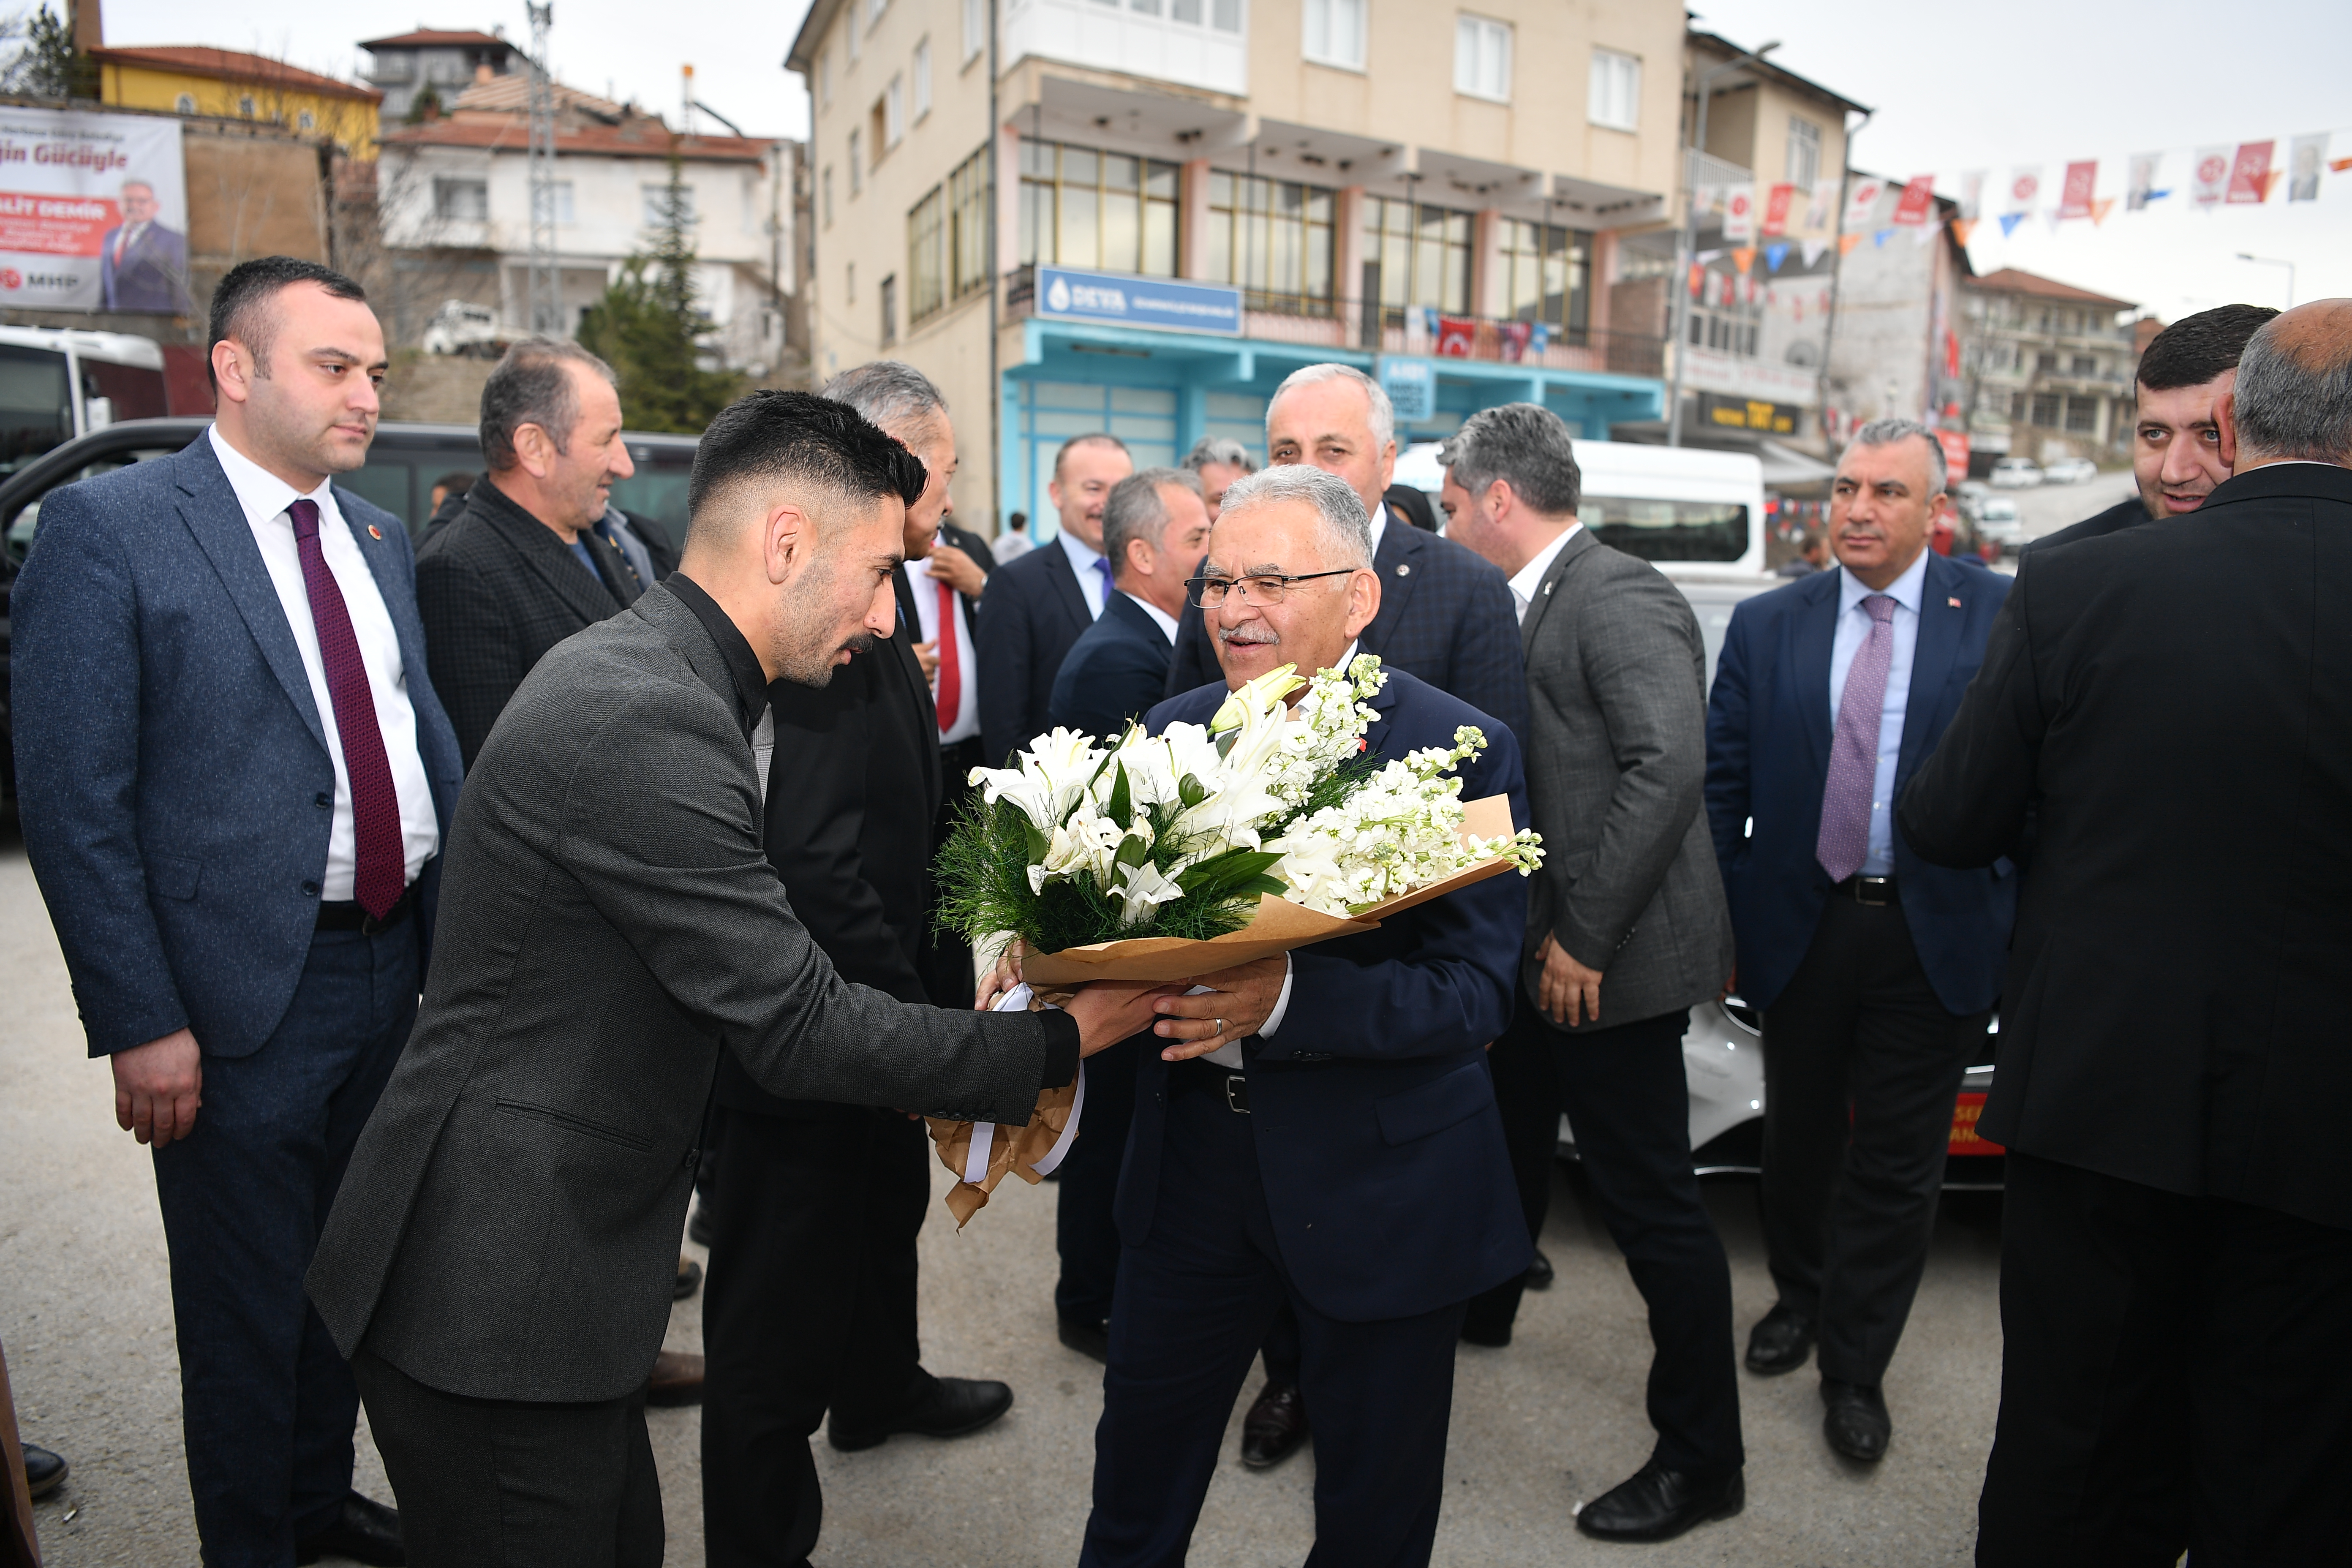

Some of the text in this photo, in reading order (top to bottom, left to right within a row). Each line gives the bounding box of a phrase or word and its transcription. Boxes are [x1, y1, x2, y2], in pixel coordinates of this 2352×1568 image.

[0, 139, 128, 172] in Gücüyle
[0, 195, 106, 221] LİT DEMİR
[27, 272, 79, 288] MHP
[1072, 284, 1127, 311] DEVA
